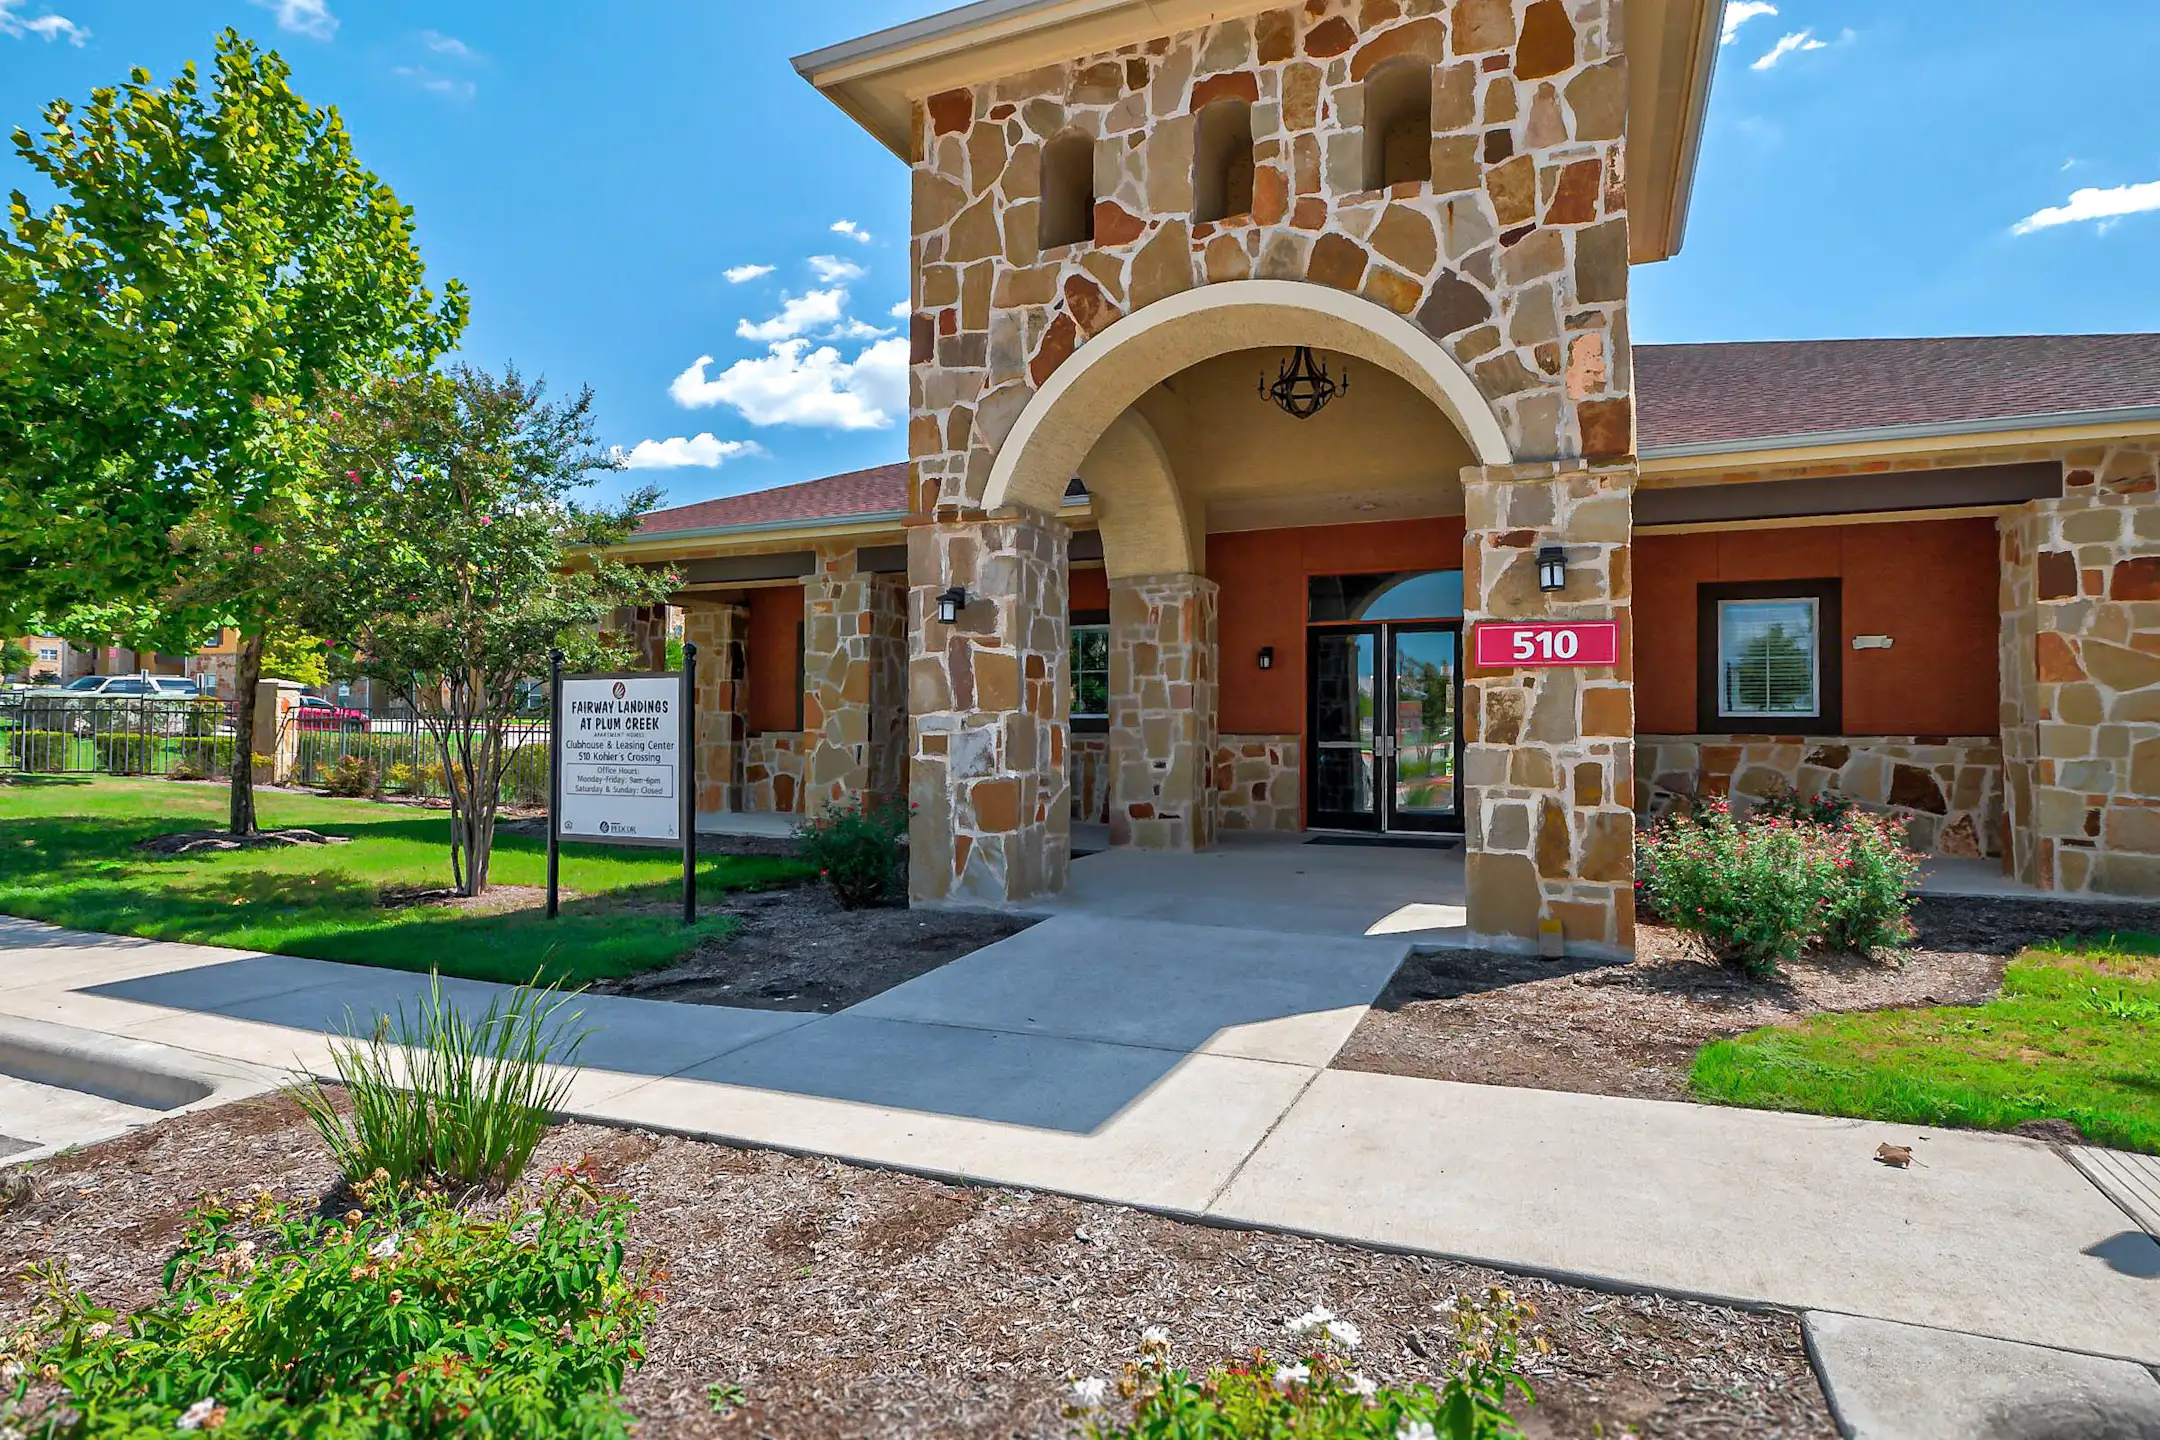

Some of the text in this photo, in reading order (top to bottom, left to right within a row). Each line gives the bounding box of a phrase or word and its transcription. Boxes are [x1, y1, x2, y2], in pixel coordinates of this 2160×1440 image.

[1513, 630, 1578, 659] 510
[572, 700, 669, 714] FAIRWAY LANDINGS
[580, 717, 659, 730] AT PLUM CREEK
[566, 740, 675, 752] Clubhouse & Leasing Center
[579, 752, 661, 764] 510 Kohler's Crossing
[619, 767, 640, 775] Hours:
[575, 785, 604, 794] Saturday
[613, 785, 639, 795] Sunday:
[641, 786, 663, 794] Closed
